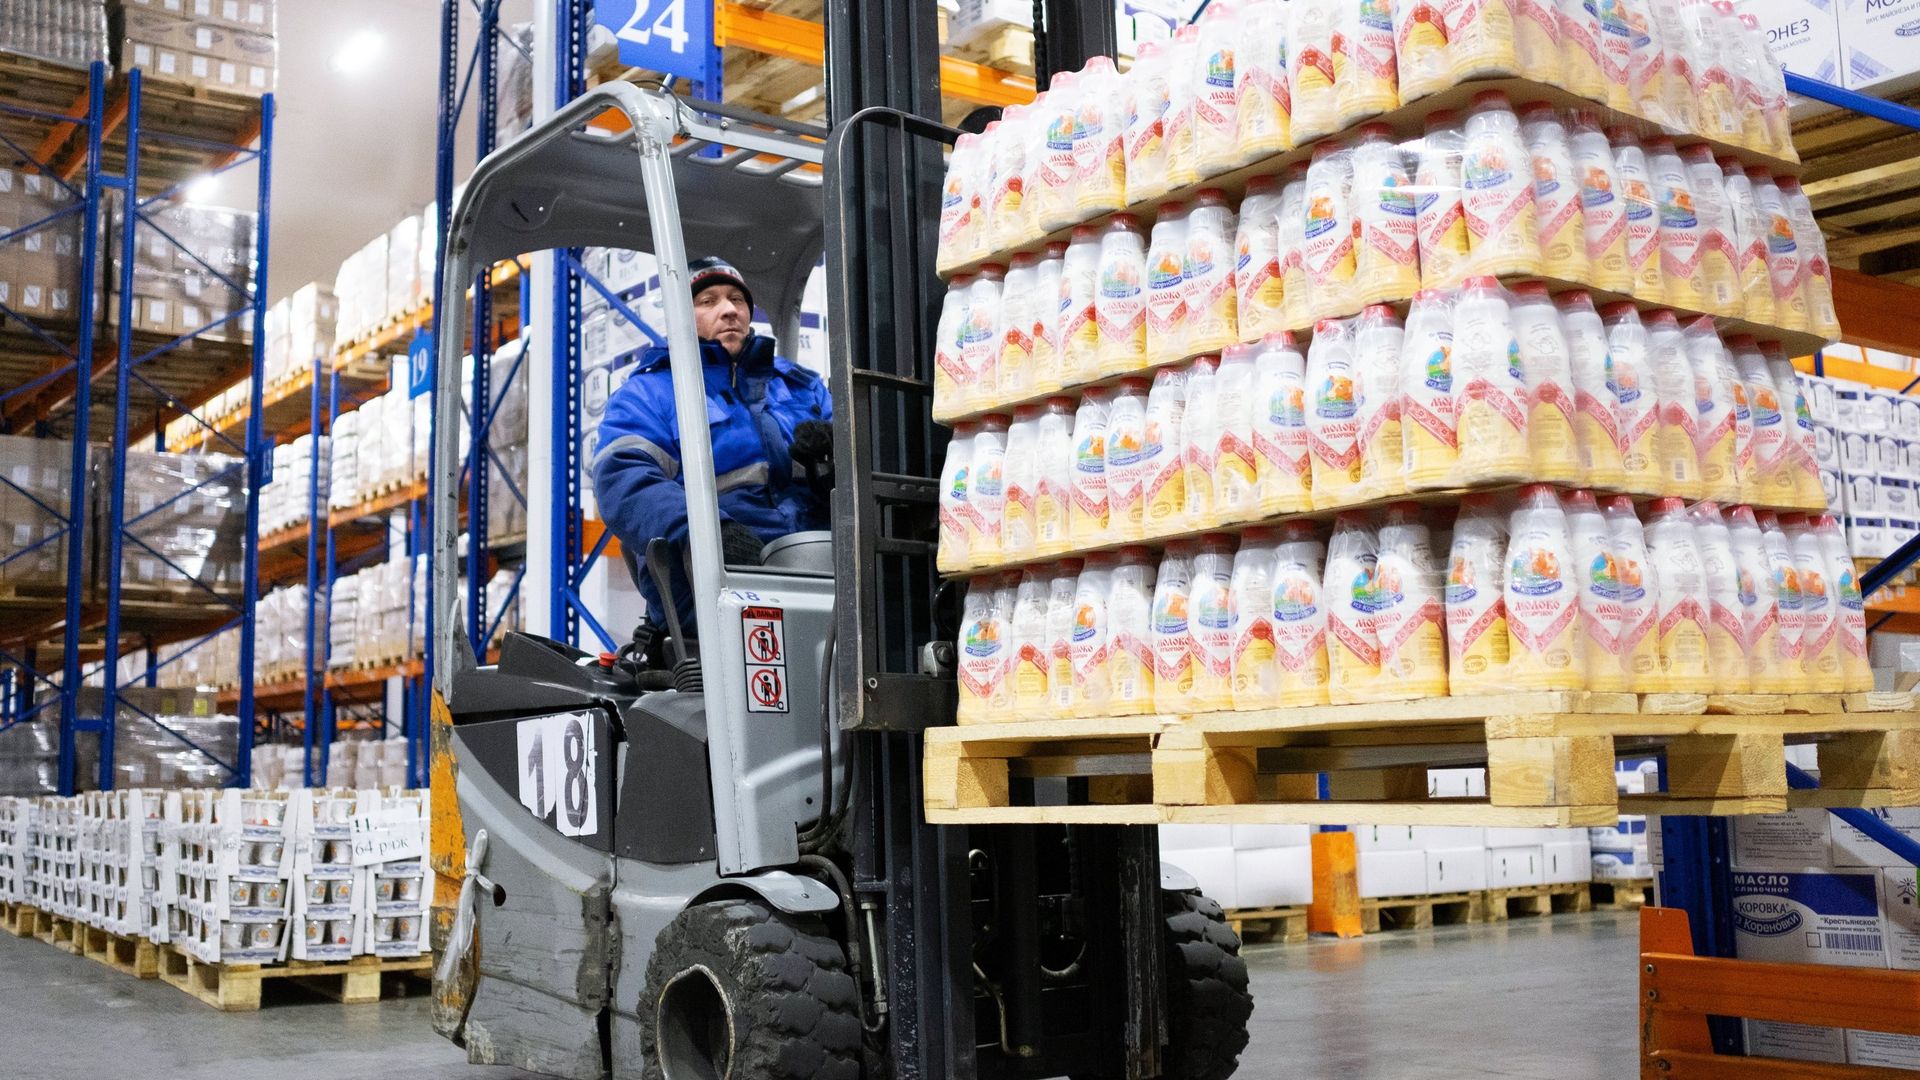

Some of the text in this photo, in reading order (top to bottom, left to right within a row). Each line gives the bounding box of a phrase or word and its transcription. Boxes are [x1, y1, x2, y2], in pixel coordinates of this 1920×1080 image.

[616, 0, 689, 54] 24
[1766, 18, 1810, 44] ОНЕЗ
[1363, 34, 1394, 42] МОЛОК
[1210, 91, 1236, 101] МОЛО
[1049, 153, 1074, 164] МОЛО
[1385, 219, 1417, 230] МОЛО
[412, 347, 428, 389] 19
[1273, 431, 1307, 442] МОЛОК
[1080, 476, 1107, 486] МОЛОК
[730, 590, 761, 602] 18
[756, 610, 780, 618] DANGER
[527, 718, 589, 828] 18
[1734, 874, 1789, 885] МАСЛО
[1734, 885, 1790, 893] сливочное
[1739, 901, 1787, 914] КОРОВКА
